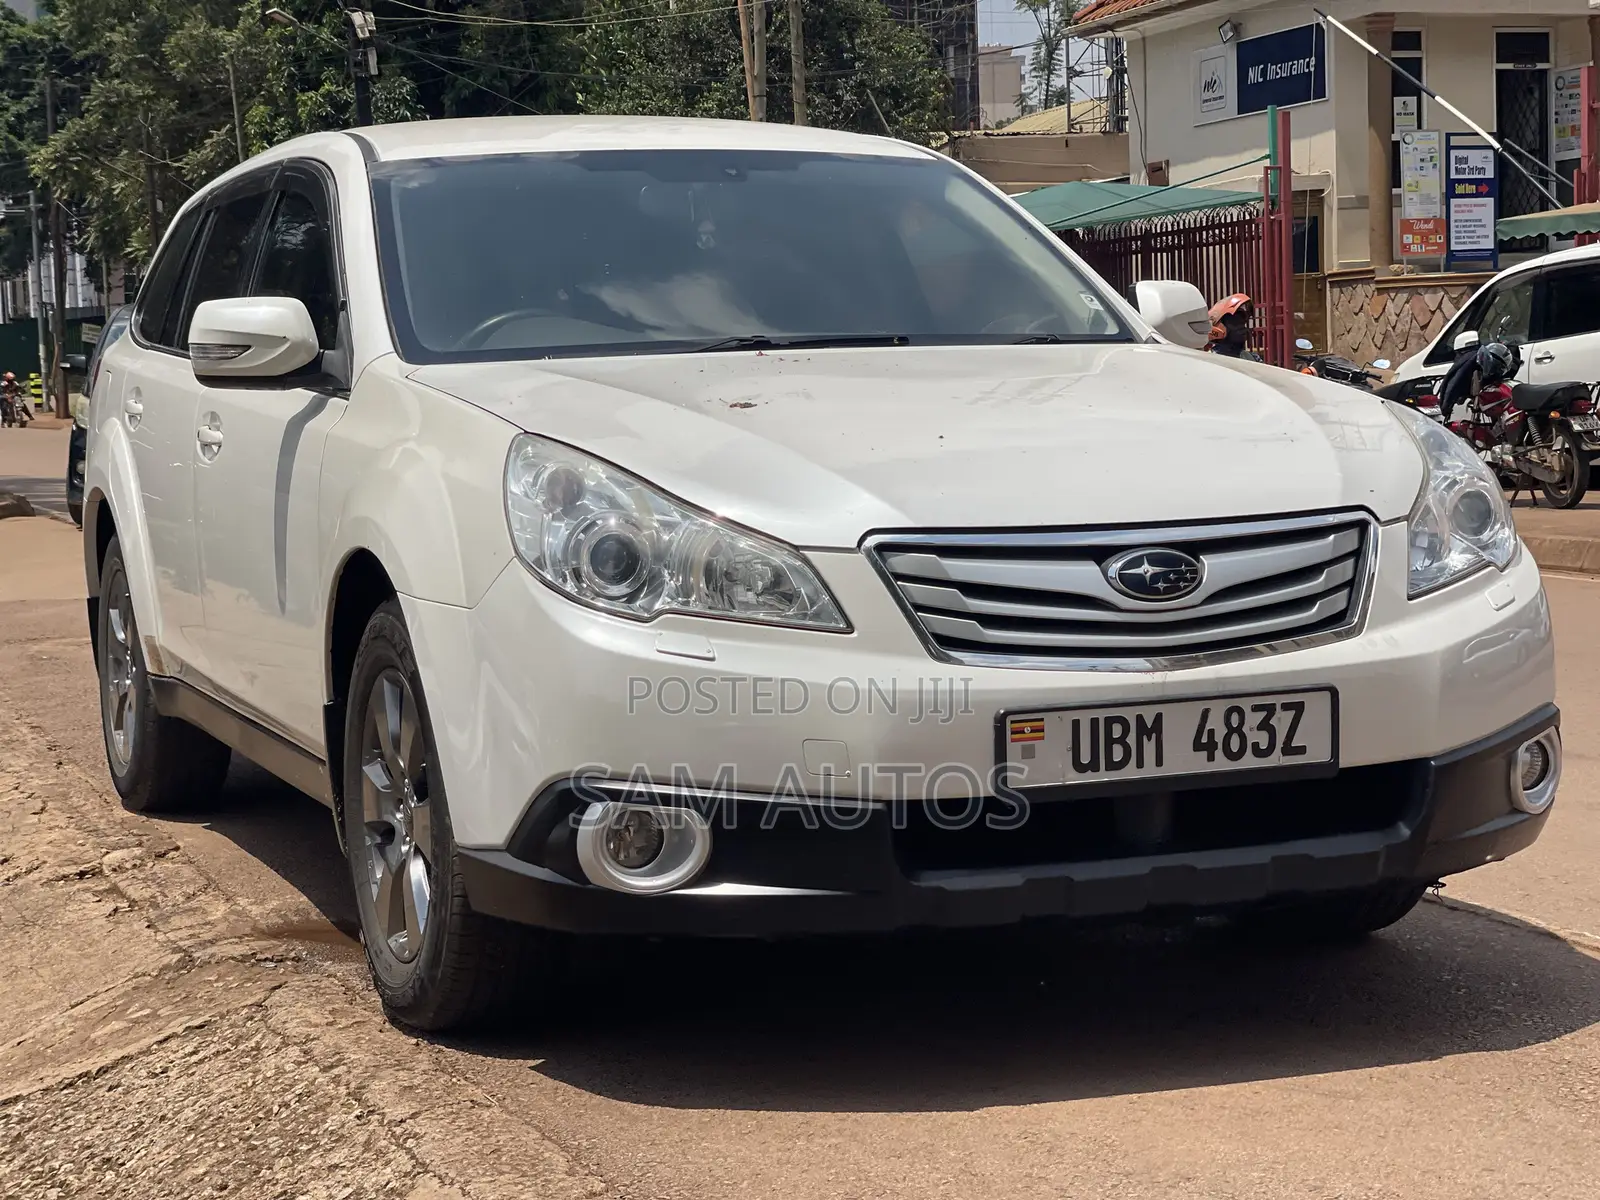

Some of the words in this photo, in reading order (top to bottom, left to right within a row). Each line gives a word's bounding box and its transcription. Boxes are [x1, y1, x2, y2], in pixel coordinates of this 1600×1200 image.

[1248, 64, 1264, 85] NIC
[1267, 56, 1316, 81] Insurance
[1475, 165, 1486, 176] Party
[1071, 711, 1164, 774] UBM
[1192, 700, 1308, 763] 483Z
